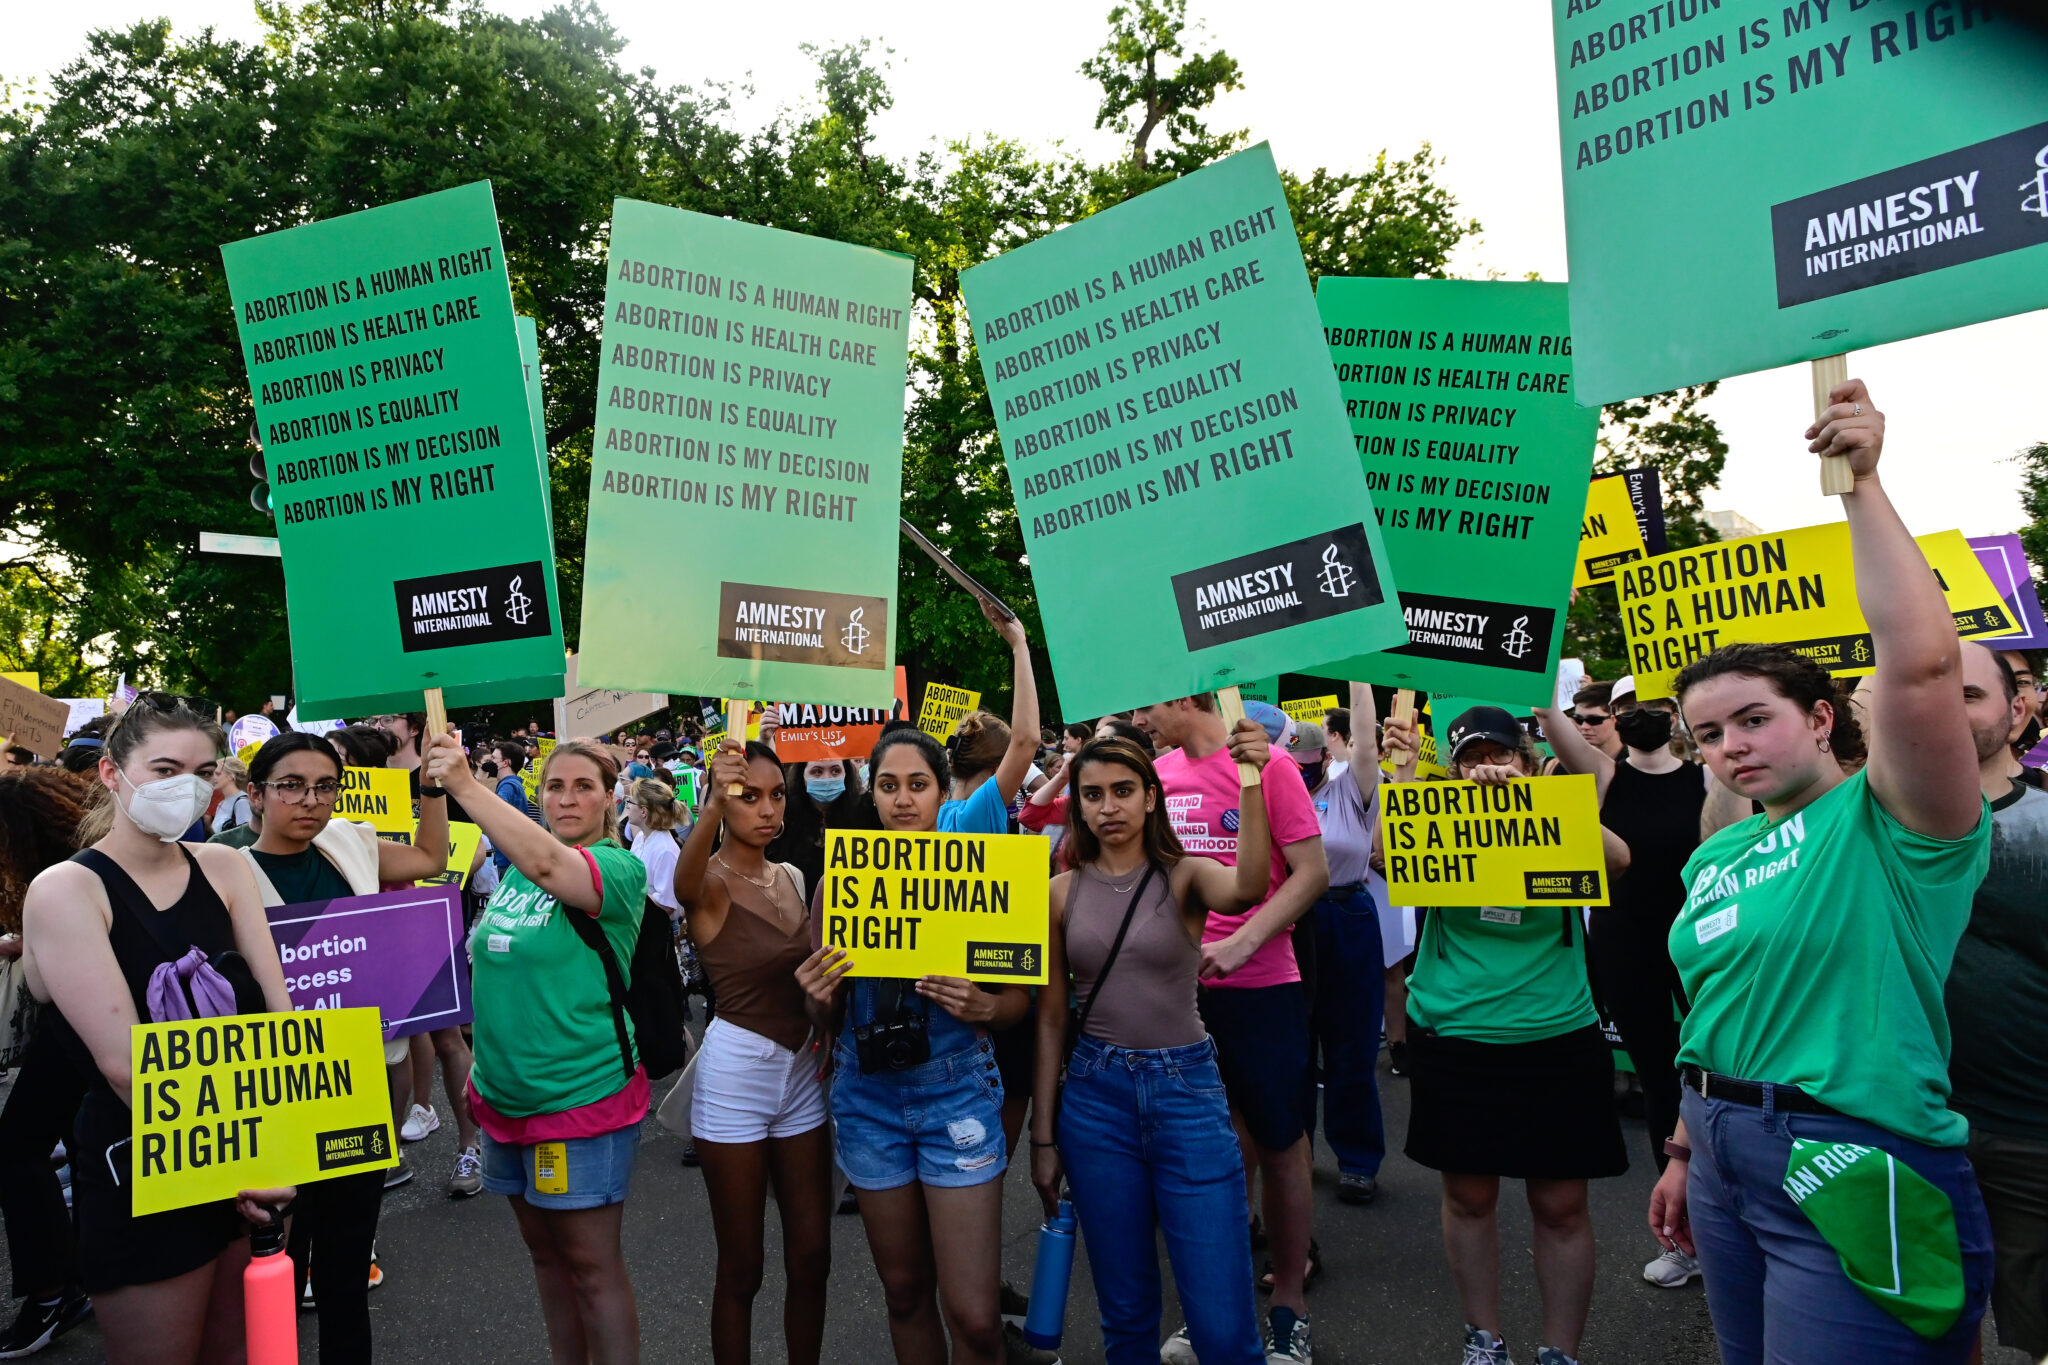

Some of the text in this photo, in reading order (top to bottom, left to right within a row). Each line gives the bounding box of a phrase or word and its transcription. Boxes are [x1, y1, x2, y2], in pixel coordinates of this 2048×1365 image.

[1574, 0, 1830, 119] ABORTION IS MY
[1577, 35, 1851, 170] ABORTION IS MY
[1805, 171, 1979, 251] AMNESTY
[1806, 213, 1984, 276] INTERNATIONAL
[245, 247, 491, 324] ABORTION IS A HUMAN RIGHT
[985, 206, 1276, 344] ABORTION IS A HUMAN RIGHT
[619, 260, 902, 330] ABORTION IS A HUMAN RIGHT
[254, 296, 480, 365] ABORTION IS HEALTH CARE
[615, 302, 876, 366] ABORTION IS HEALTH CARE
[995, 260, 1264, 383] ABORTION IS HEALTH CARE
[1419, 332, 1572, 356] IS A HUMAN RIG
[262, 348, 443, 405] ABORTION IS PRIVACY
[612, 344, 831, 398] ABORTION IS PRIVACY
[1005, 321, 1220, 421] ABORTION IS PRIVACY
[1414, 368, 1569, 393] IS HEALTH CARE
[270, 389, 458, 445] ABORTION IS EQUALITY
[609, 386, 837, 439] ABORTION IS EQUALITY
[1015, 359, 1241, 460] ABORTION IS EQUALITY
[1347, 400, 1516, 427] RTION IS PRIVACY
[278, 425, 500, 485] ABORTION IS MY DECISION
[606, 428, 869, 484] ABORTION IS MY DECISION
[1024, 387, 1298, 499] ABORTION IS MY DECISION
[1402, 439, 1519, 464] IS EQUALITY
[285, 464, 494, 524] ABORTION IS MY RIGHT
[602, 470, 857, 522] ABORTION IS MY RIGHT
[1034, 429, 1293, 538] ABORTION IS MY RIGHT
[1397, 474, 1414, 493] IS
[1421, 476, 1449, 495] MY
[1455, 479, 1550, 504] DECISION
[1392, 509, 1409, 528] IS
[1416, 507, 1451, 531] MY
[1458, 511, 1534, 539] RIGHT
[1196, 562, 1293, 611] AMNESTY
[1624, 539, 1787, 601] ABORTION
[413, 586, 487, 617] AMNESTY
[736, 601, 826, 630] AMNESTY
[1200, 591, 1302, 629] INTERNATIONAL
[1628, 574, 1825, 637] IS A HUMAN
[414, 612, 492, 634] INTERNATIONAL
[736, 627, 824, 648] INTERNATIONAL
[1403, 607, 1489, 634] AMNESTY
[1408, 630, 1483, 650] TERNATIONAL
[924, 702, 971, 721] IS A HUM
[927, 686, 970, 706] ABORTION
[1283, 699, 1322, 712] ABORTION
[1301, 709, 1325, 720] HUMA
[781, 730, 842, 742] EMILY'S LIST
[920, 717, 949, 735] RIGHT
[333, 793, 388, 815] UMAN
[1167, 796, 1200, 809] STAND
[1386, 783, 1533, 817] ABORTION
[1389, 817, 1561, 849] IS A HUMAN
[830, 837, 984, 873] ABORTION
[1391, 854, 1477, 883] RIGHT
[1745, 848, 1800, 889] RIGHT
[832, 876, 1008, 913] IS A HUMAN
[1532, 878, 1571, 886] AMNESTY
[281, 934, 367, 964] bortion
[829, 916, 921, 950] RIGHT
[974, 949, 1013, 960] AMNESTY
[284, 966, 353, 993] ccess
[140, 1018, 324, 1074] ABORTION
[144, 1059, 352, 1124] IS A HUMAN
[142, 1116, 262, 1177] RIGHT
[325, 1136, 363, 1152] AMNESTY
